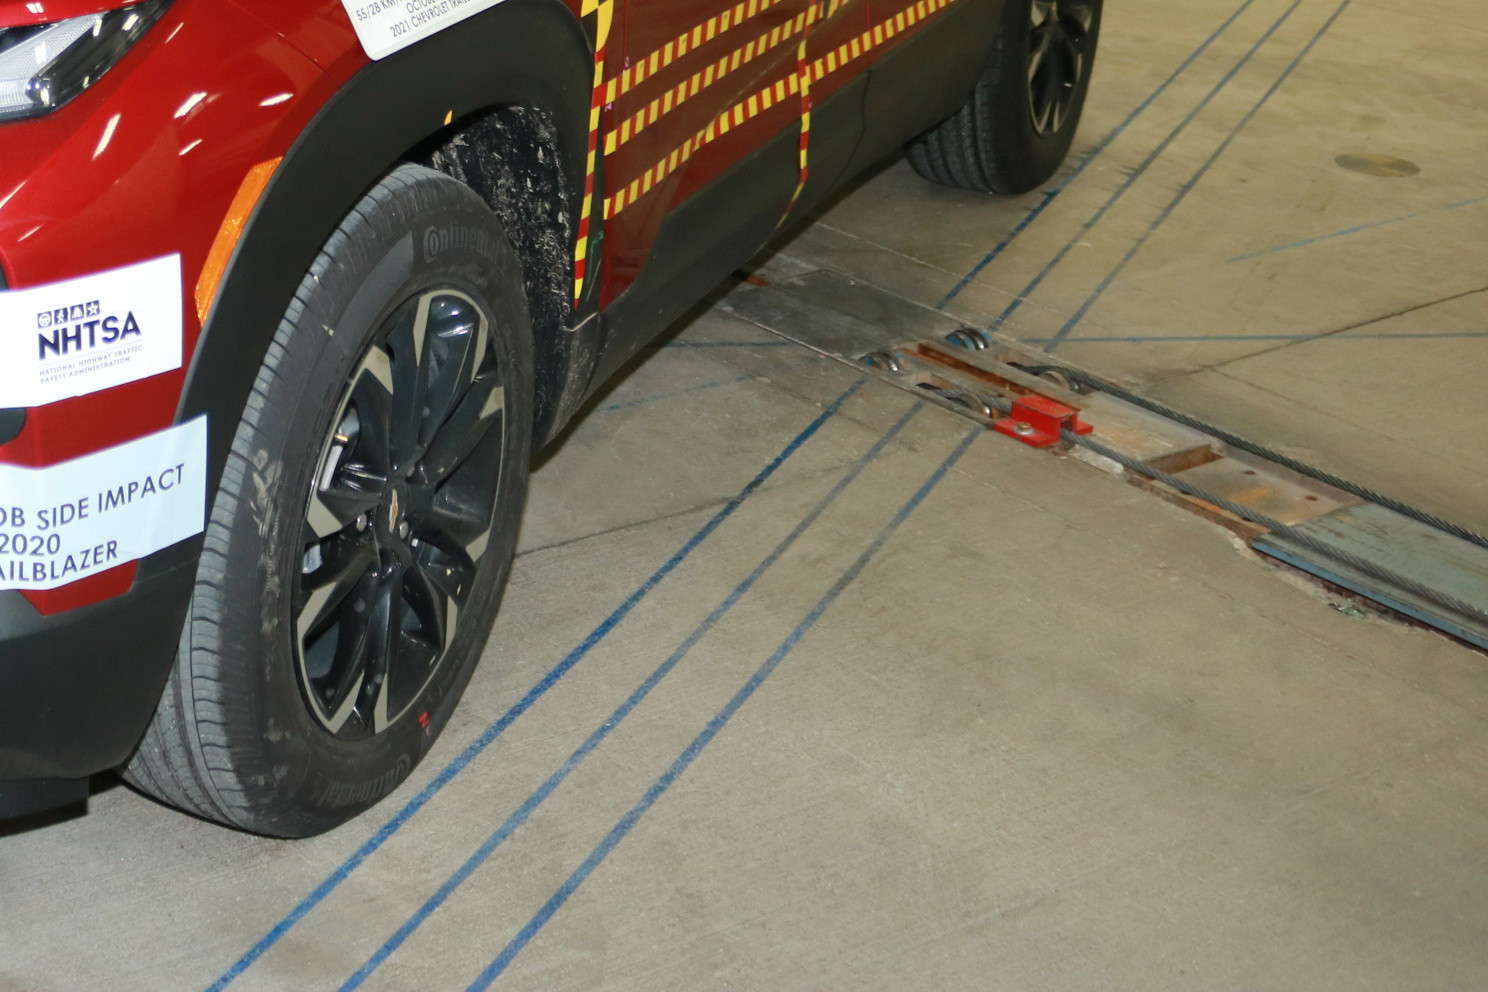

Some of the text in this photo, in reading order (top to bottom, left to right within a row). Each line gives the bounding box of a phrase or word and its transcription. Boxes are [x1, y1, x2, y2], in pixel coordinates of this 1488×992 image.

[356, 2, 381, 21] 55/28
[390, 20, 411, 38] 2021
[411, 1, 451, 28] CHEVROLET
[38, 310, 142, 361] NHTSA
[39, 345, 143, 376] NATIONAL HIGHWAY TRAFFIC
[39, 356, 130, 384] SAFETY ADMINISTRATION
[36, 497, 89, 531] SIDE
[98, 463, 185, 514] IMPACT
